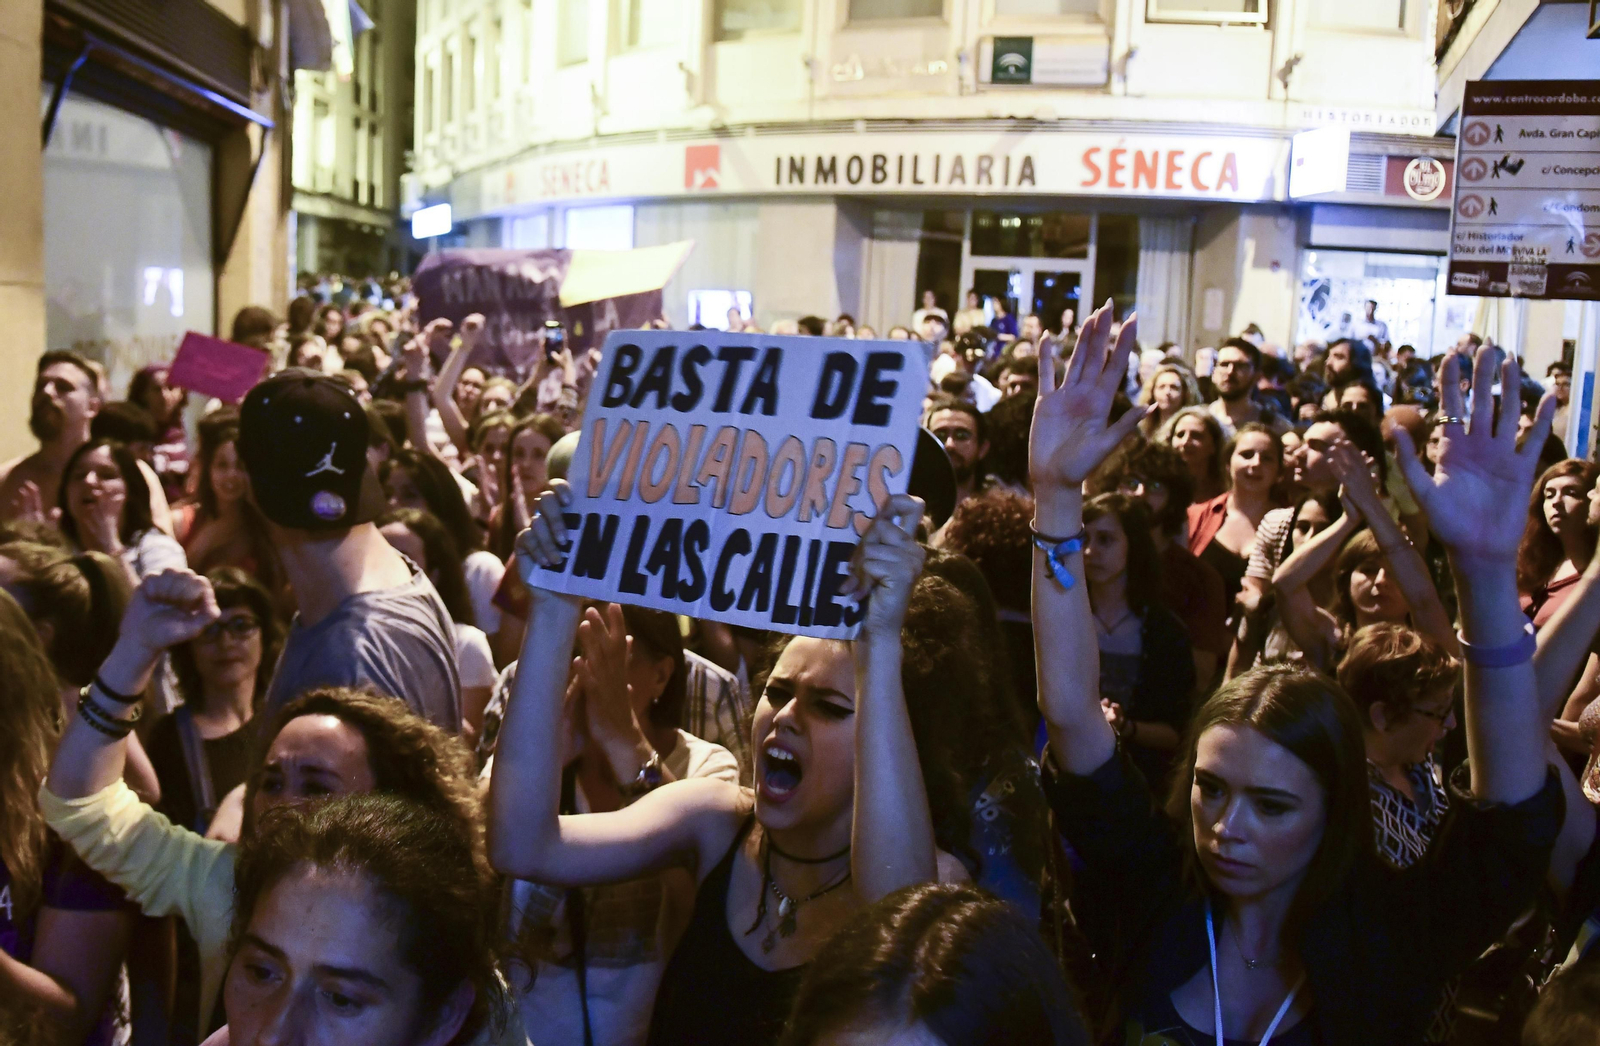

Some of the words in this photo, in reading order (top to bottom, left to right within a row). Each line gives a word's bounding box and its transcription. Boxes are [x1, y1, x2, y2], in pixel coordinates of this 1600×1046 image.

[1303, 110, 1431, 127] HISTORIADOR
[1520, 128, 1547, 139] Avda.
[1550, 128, 1574, 139] Gran
[775, 153, 1036, 186] INMOBILIARIA
[1081, 137, 1239, 192] SÉNECA
[601, 344, 783, 417] BASTA
[810, 351, 905, 427] DE
[587, 418, 904, 538] VIOLADORES
[618, 514, 710, 603] LAS
